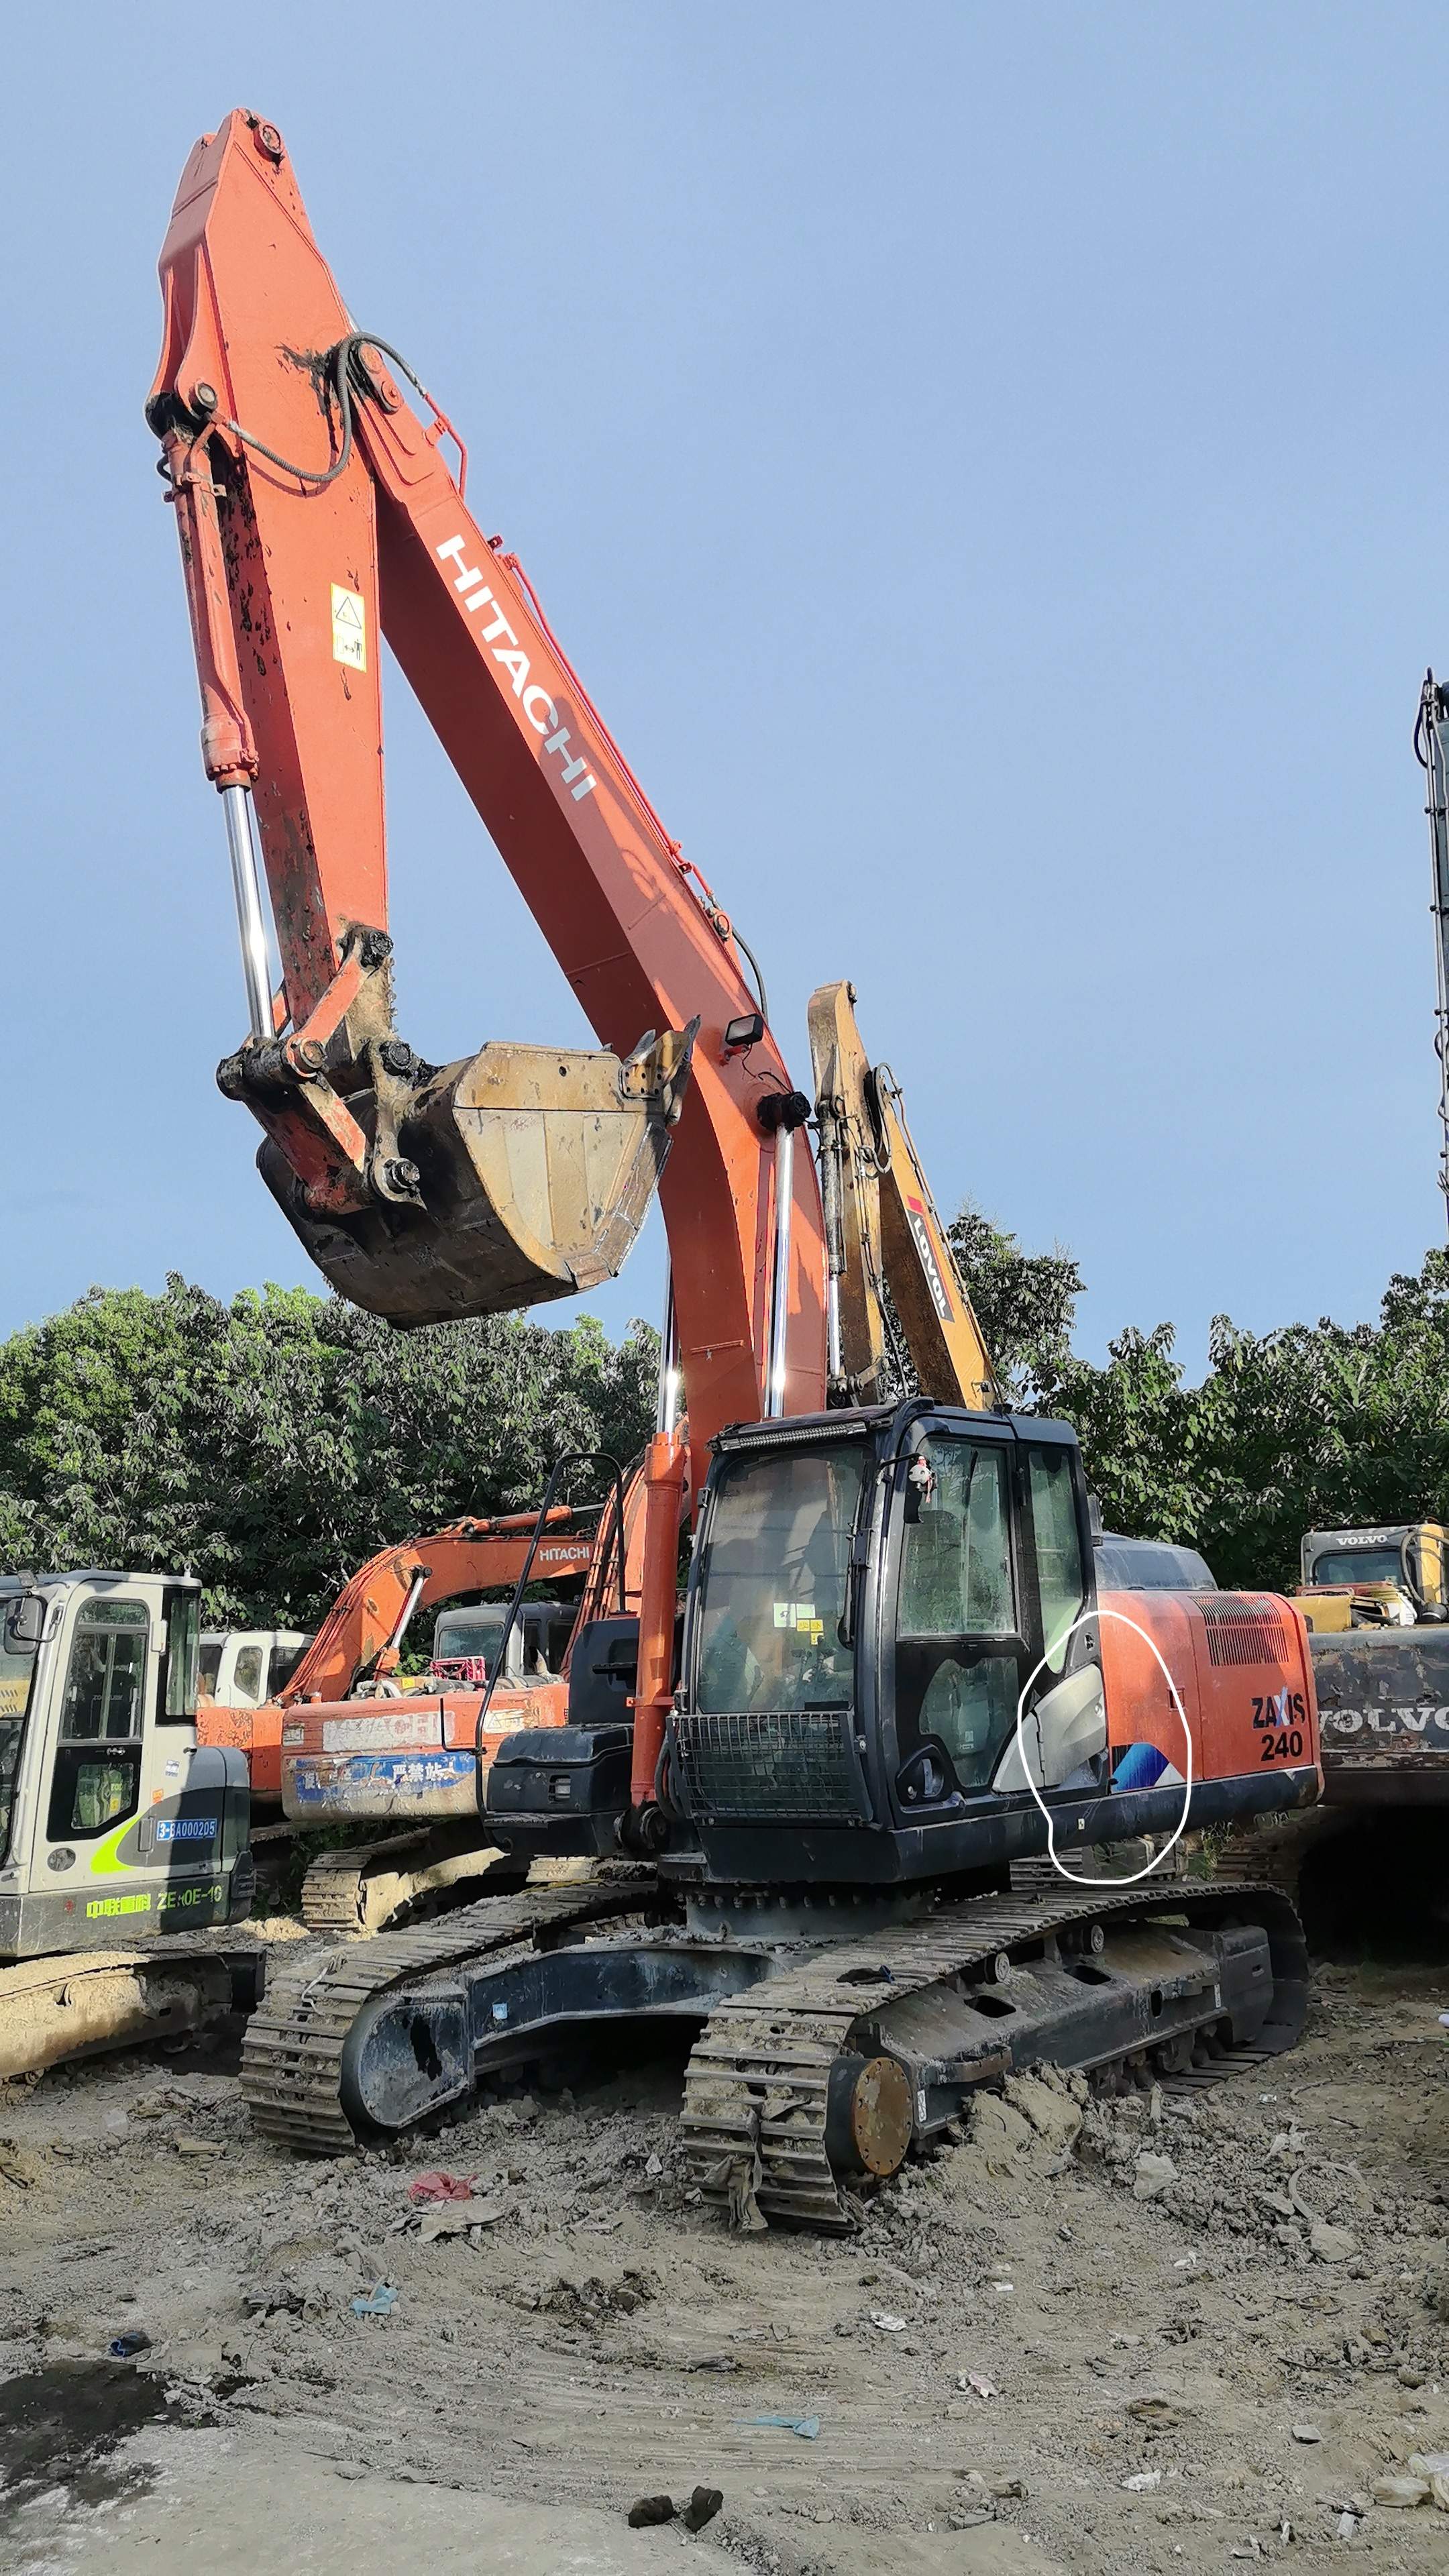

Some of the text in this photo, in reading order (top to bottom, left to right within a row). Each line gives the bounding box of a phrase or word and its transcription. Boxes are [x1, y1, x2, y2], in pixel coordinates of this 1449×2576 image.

[436, 535, 596, 801] HITACHI
[914, 1217, 946, 1318] LOVOL
[539, 1546, 590, 1561] HITACHI
[1336, 1534, 1388, 1546] VOLVO
[1250, 1686, 1305, 1729] ZAXIS
[1260, 1730, 1303, 1761] 240
[87, 1893, 151, 1919] 中联重科
